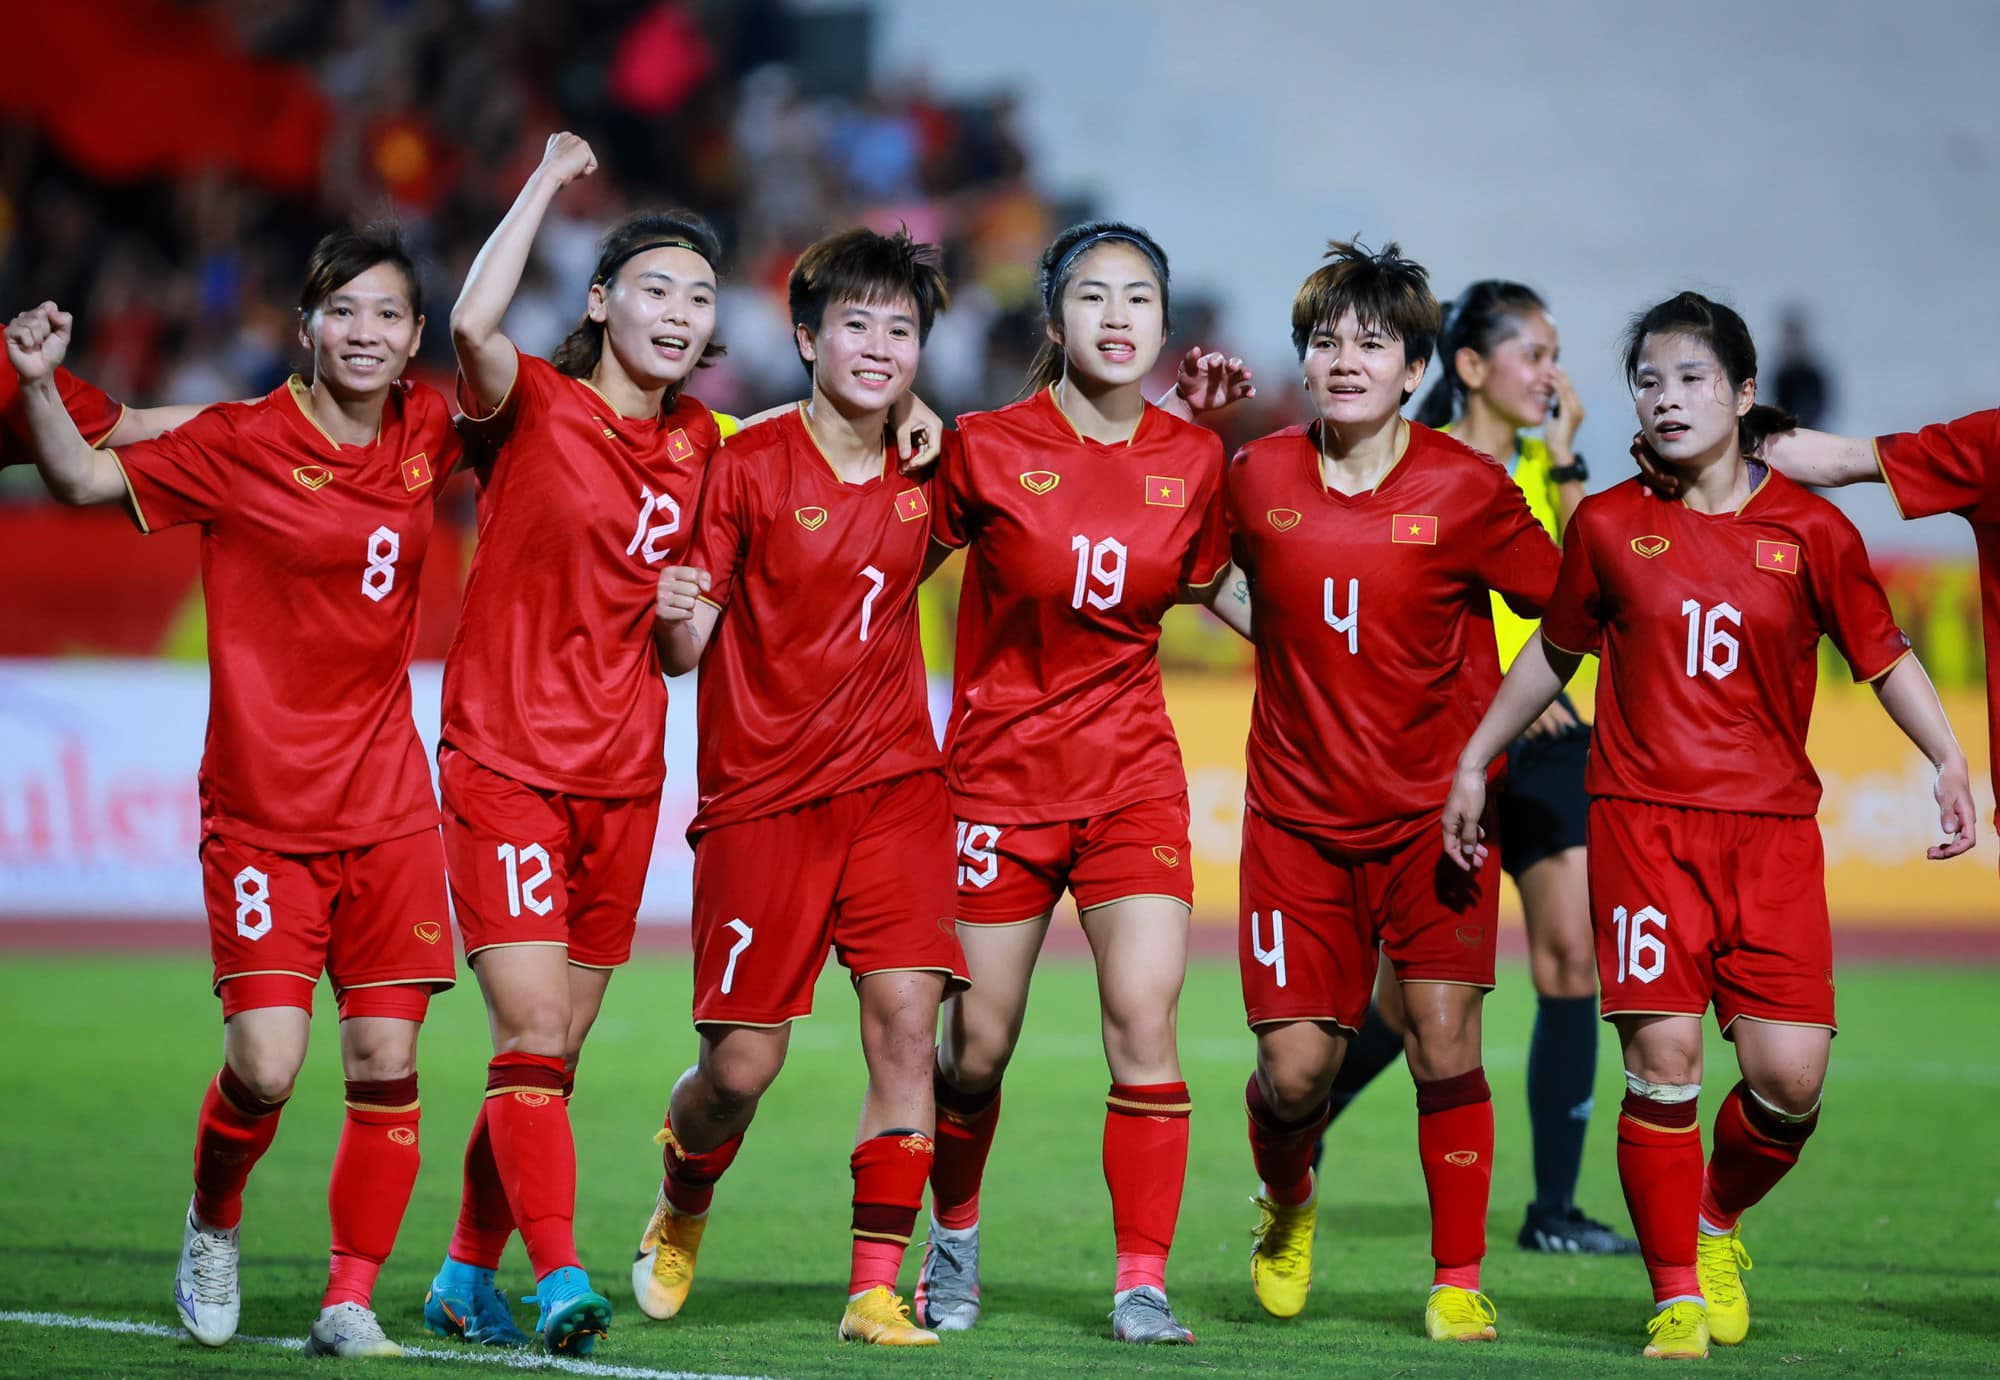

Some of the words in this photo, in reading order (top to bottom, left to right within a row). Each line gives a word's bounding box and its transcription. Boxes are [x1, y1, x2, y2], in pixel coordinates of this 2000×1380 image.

[624, 484, 681, 564] 12
[361, 525, 400, 602] 8
[1071, 534, 1127, 610] 19
[858, 565, 885, 642] 7
[1323, 576, 1359, 655] 4
[1681, 598, 1742, 681] 16
[233, 865, 273, 941] 8
[496, 842, 554, 918] 12
[720, 917, 754, 995] 7
[1251, 909, 1287, 988] 4
[1612, 905, 1667, 984] 16
